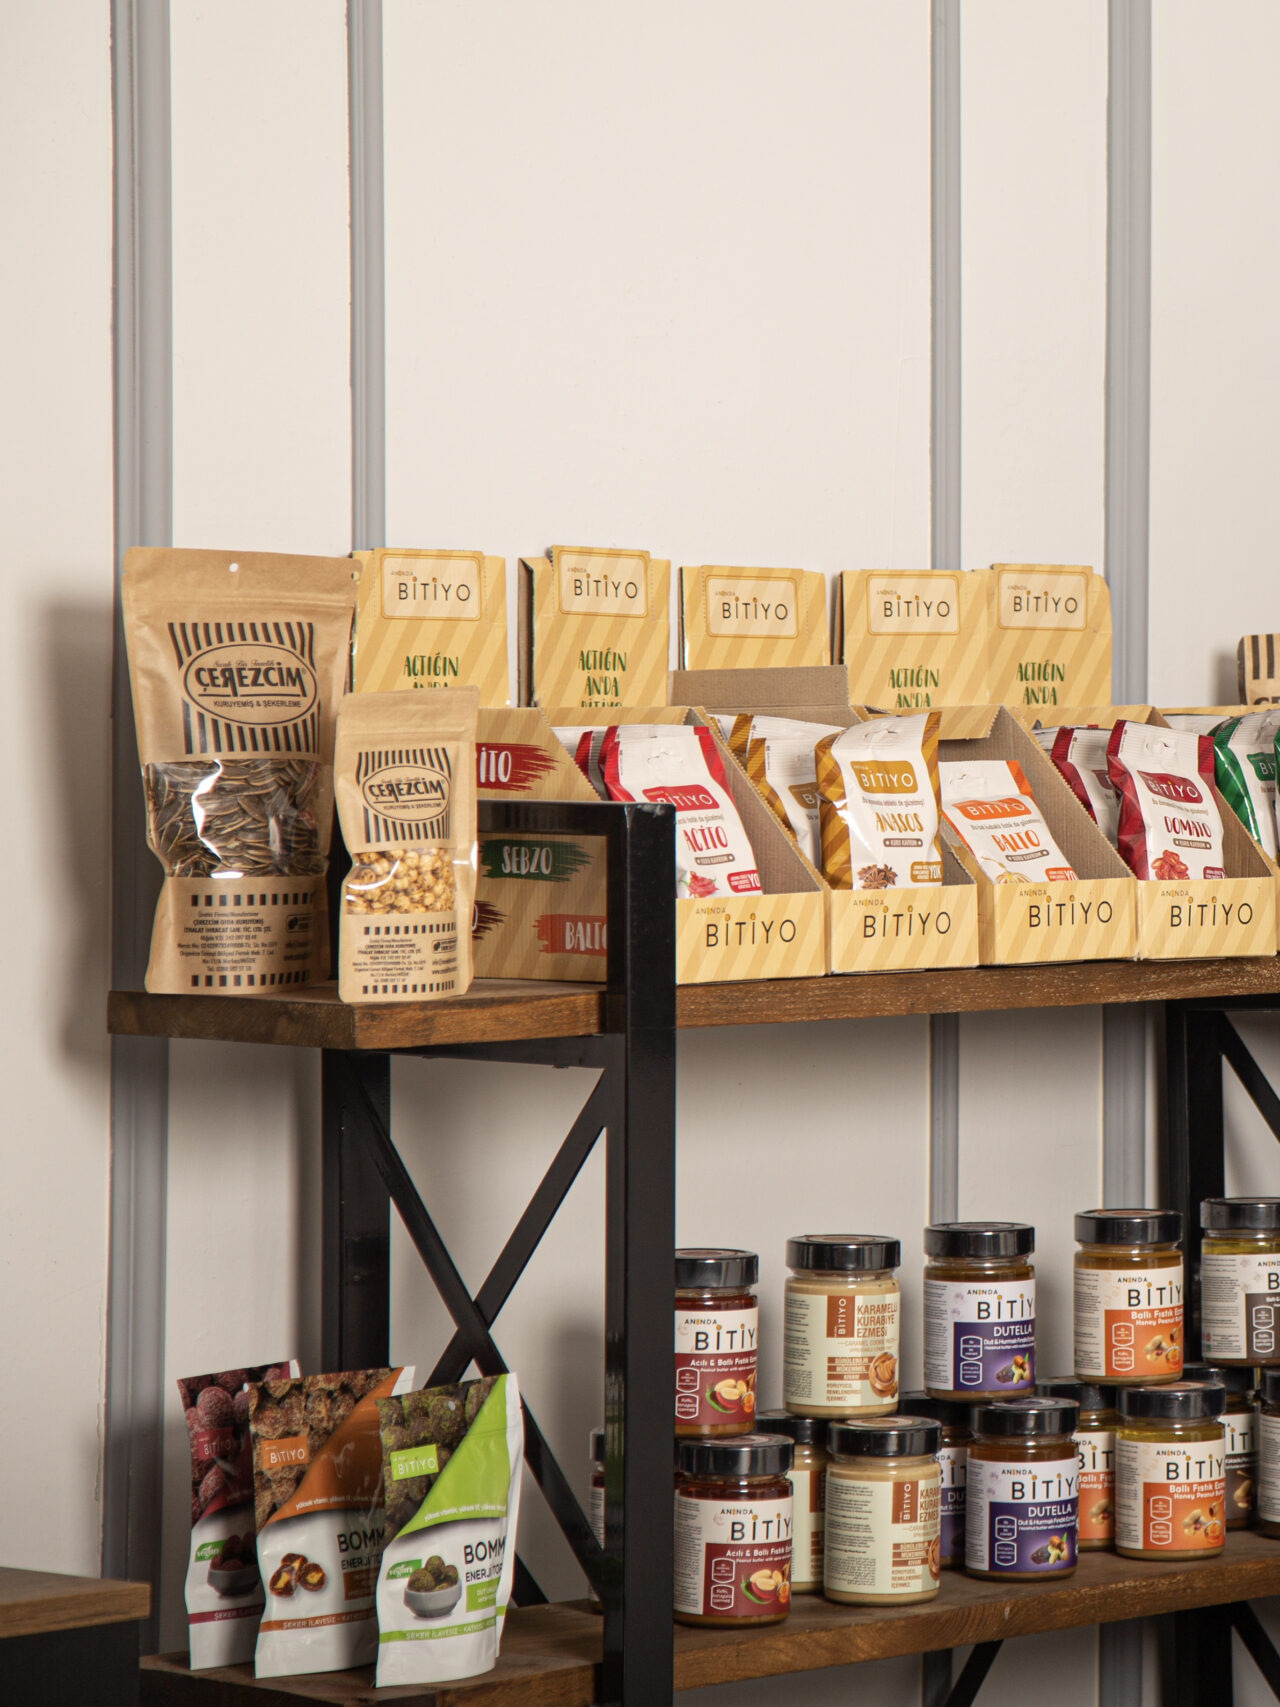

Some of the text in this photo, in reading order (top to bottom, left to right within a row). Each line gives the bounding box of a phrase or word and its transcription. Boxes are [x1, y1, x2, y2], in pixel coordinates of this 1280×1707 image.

[479, 747, 511, 783] İTO
[875, 812, 924, 833] ANASOS
[991, 830, 1040, 852] BALTO
[501, 845, 552, 875] SEBZO
[748, 873, 761, 887] YO
[977, 1293, 1033, 1320] BİTİY
[1128, 1280, 1181, 1307] BİTİY
[695, 1323, 756, 1351] BİTİY
[993, 1324, 1032, 1337] DUTELLA
[1166, 1454, 1223, 1480] BİTİY
[1028, 1503, 1072, 1517] DUTELLA
[731, 1513, 791, 1541] BİTİY
